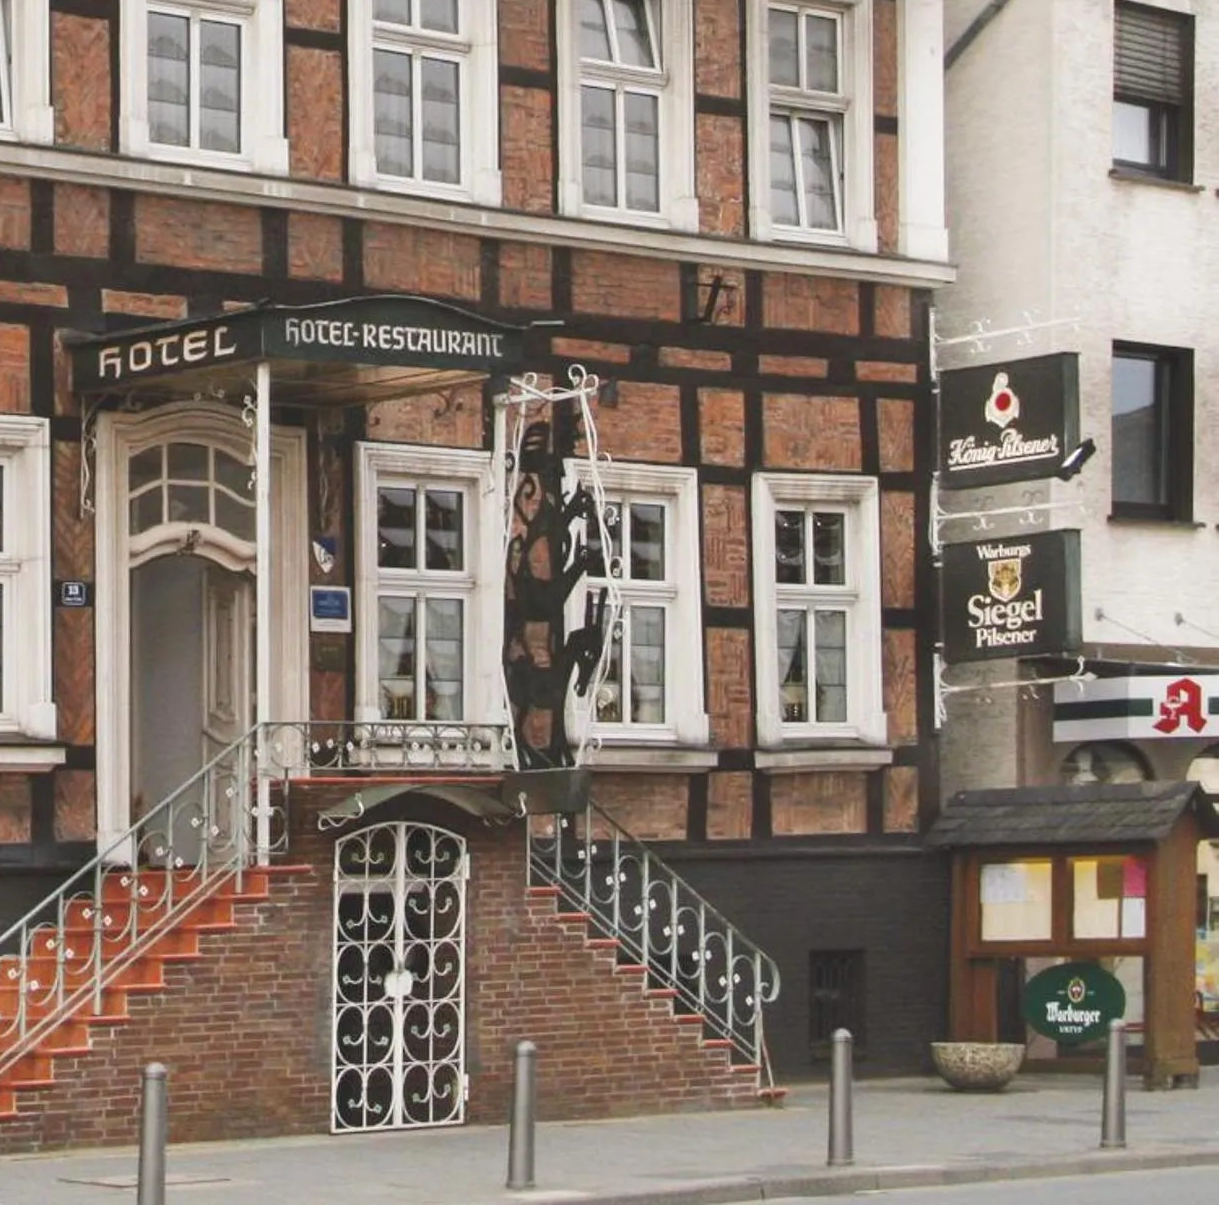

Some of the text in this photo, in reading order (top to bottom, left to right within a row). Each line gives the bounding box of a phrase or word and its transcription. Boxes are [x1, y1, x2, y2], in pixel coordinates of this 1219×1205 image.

[98, 326, 237, 379] HOTEL
[968, 589, 1043, 629] Siegel
[976, 627, 1037, 648] Pilsener
